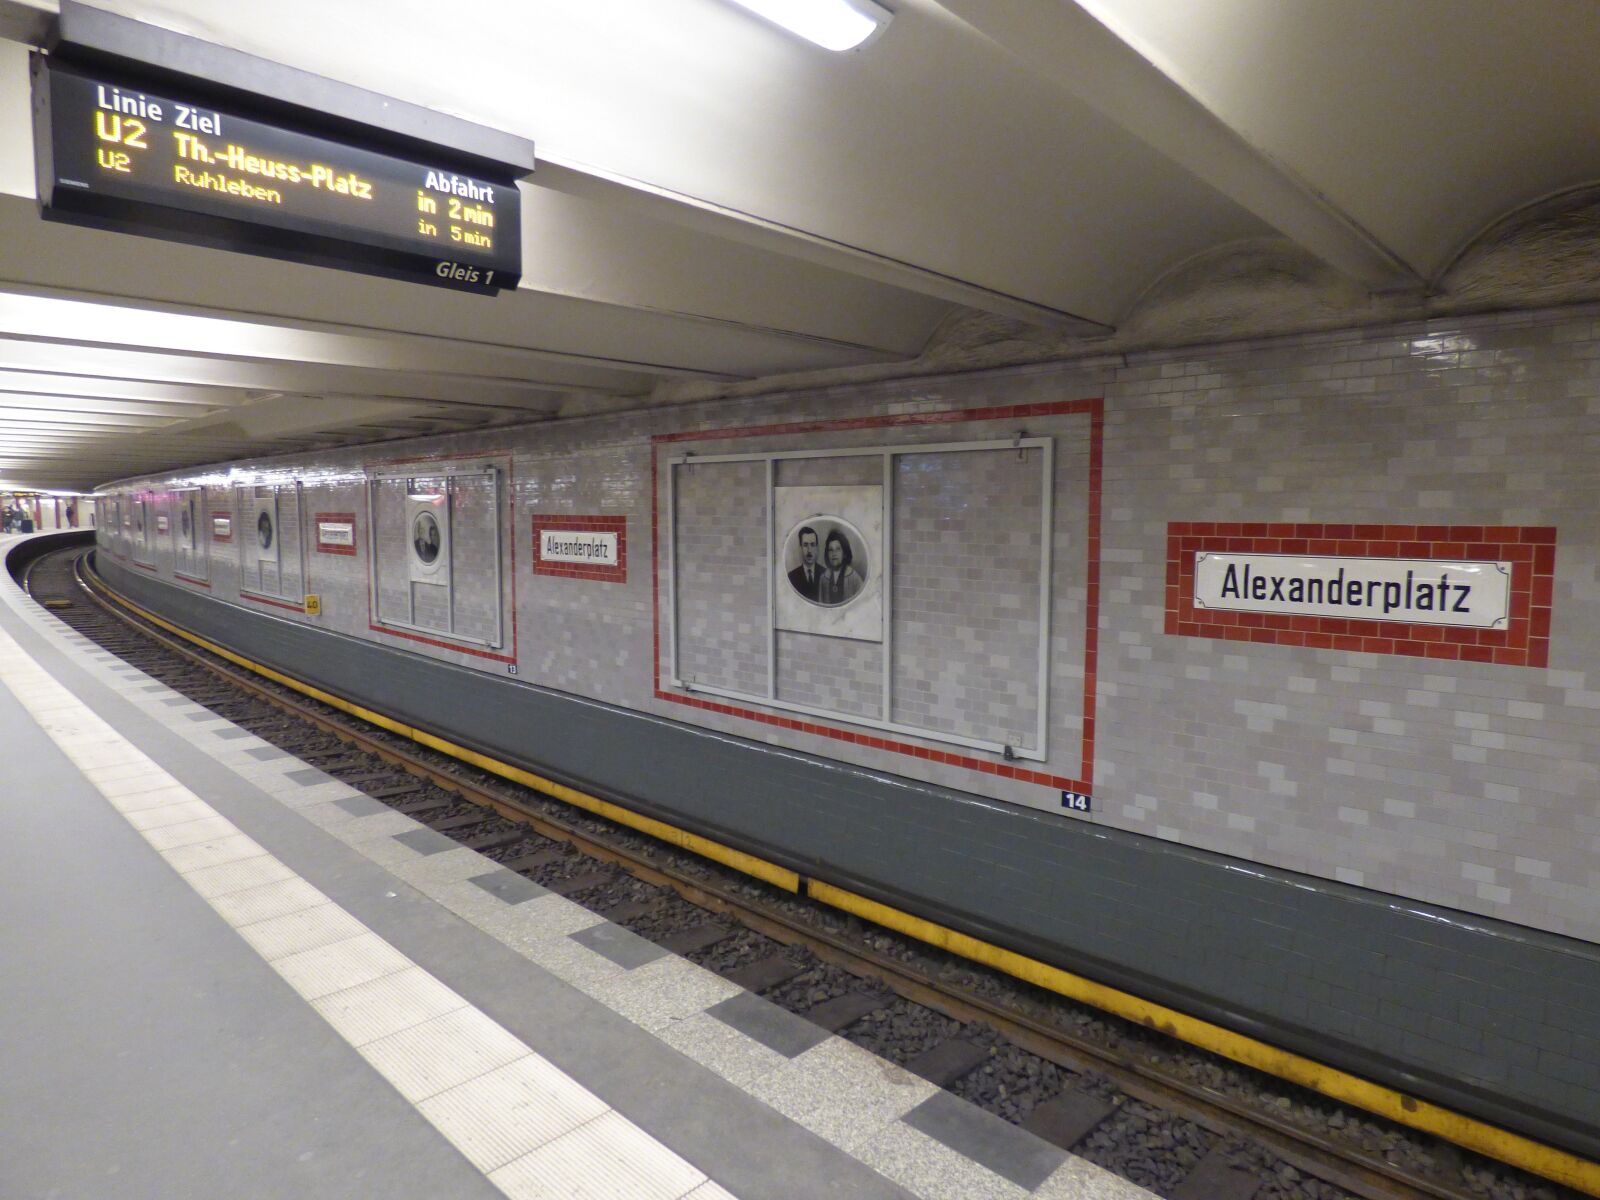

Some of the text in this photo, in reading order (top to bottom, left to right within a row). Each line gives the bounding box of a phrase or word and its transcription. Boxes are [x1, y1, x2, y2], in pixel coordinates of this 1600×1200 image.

[97, 85, 221, 136] Linie Ziel
[96, 111, 373, 200] U2 Th.-Heuss-Platz
[97, 148, 281, 204] U2 Ruhleben
[425, 171, 495, 203] Abfahrt
[417, 189, 494, 227] in 2 min
[418, 218, 492, 248] in 5 min
[436, 261, 495, 285] Gleis 1
[546, 535, 608, 560] Alexanderplatz
[1220, 563, 1472, 614] Alexanderplatz
[1065, 793, 1088, 810] 14
